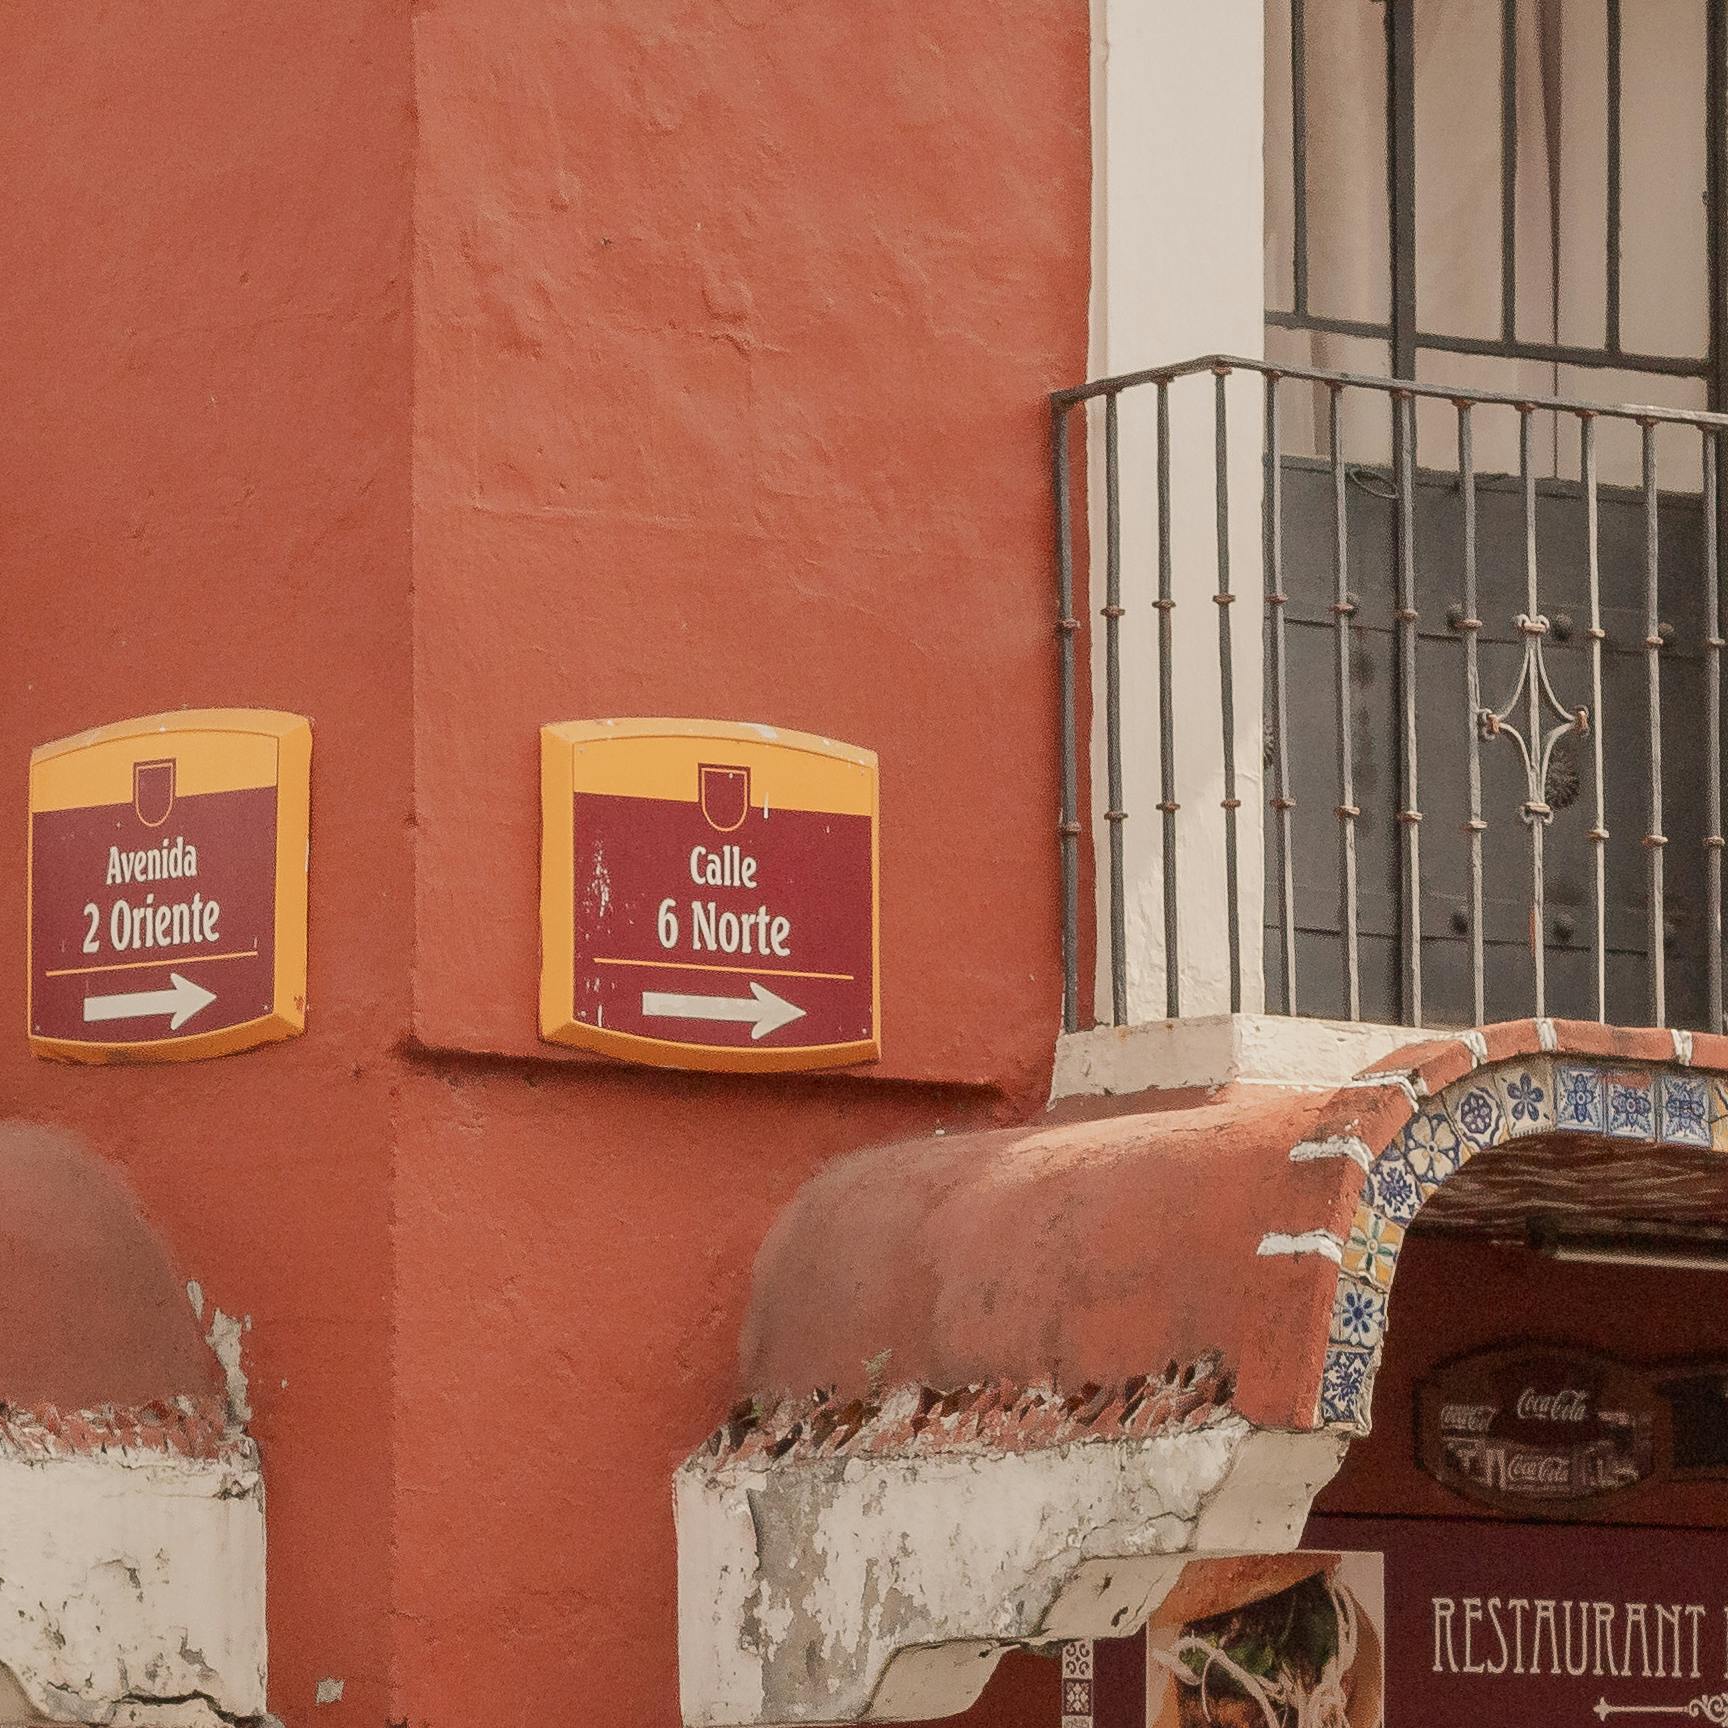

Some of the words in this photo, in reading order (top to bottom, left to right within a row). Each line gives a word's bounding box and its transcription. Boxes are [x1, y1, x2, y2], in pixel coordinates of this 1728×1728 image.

[106, 837, 198, 885] Avenida
[688, 844, 757, 889] Calle
[82, 903, 100, 954] 2
[109, 893, 221, 950] Oriente
[655, 899, 679, 949] 6
[691, 902, 790, 957] Norte
[1432, 1597, 1706, 1677] RESTAURANT
